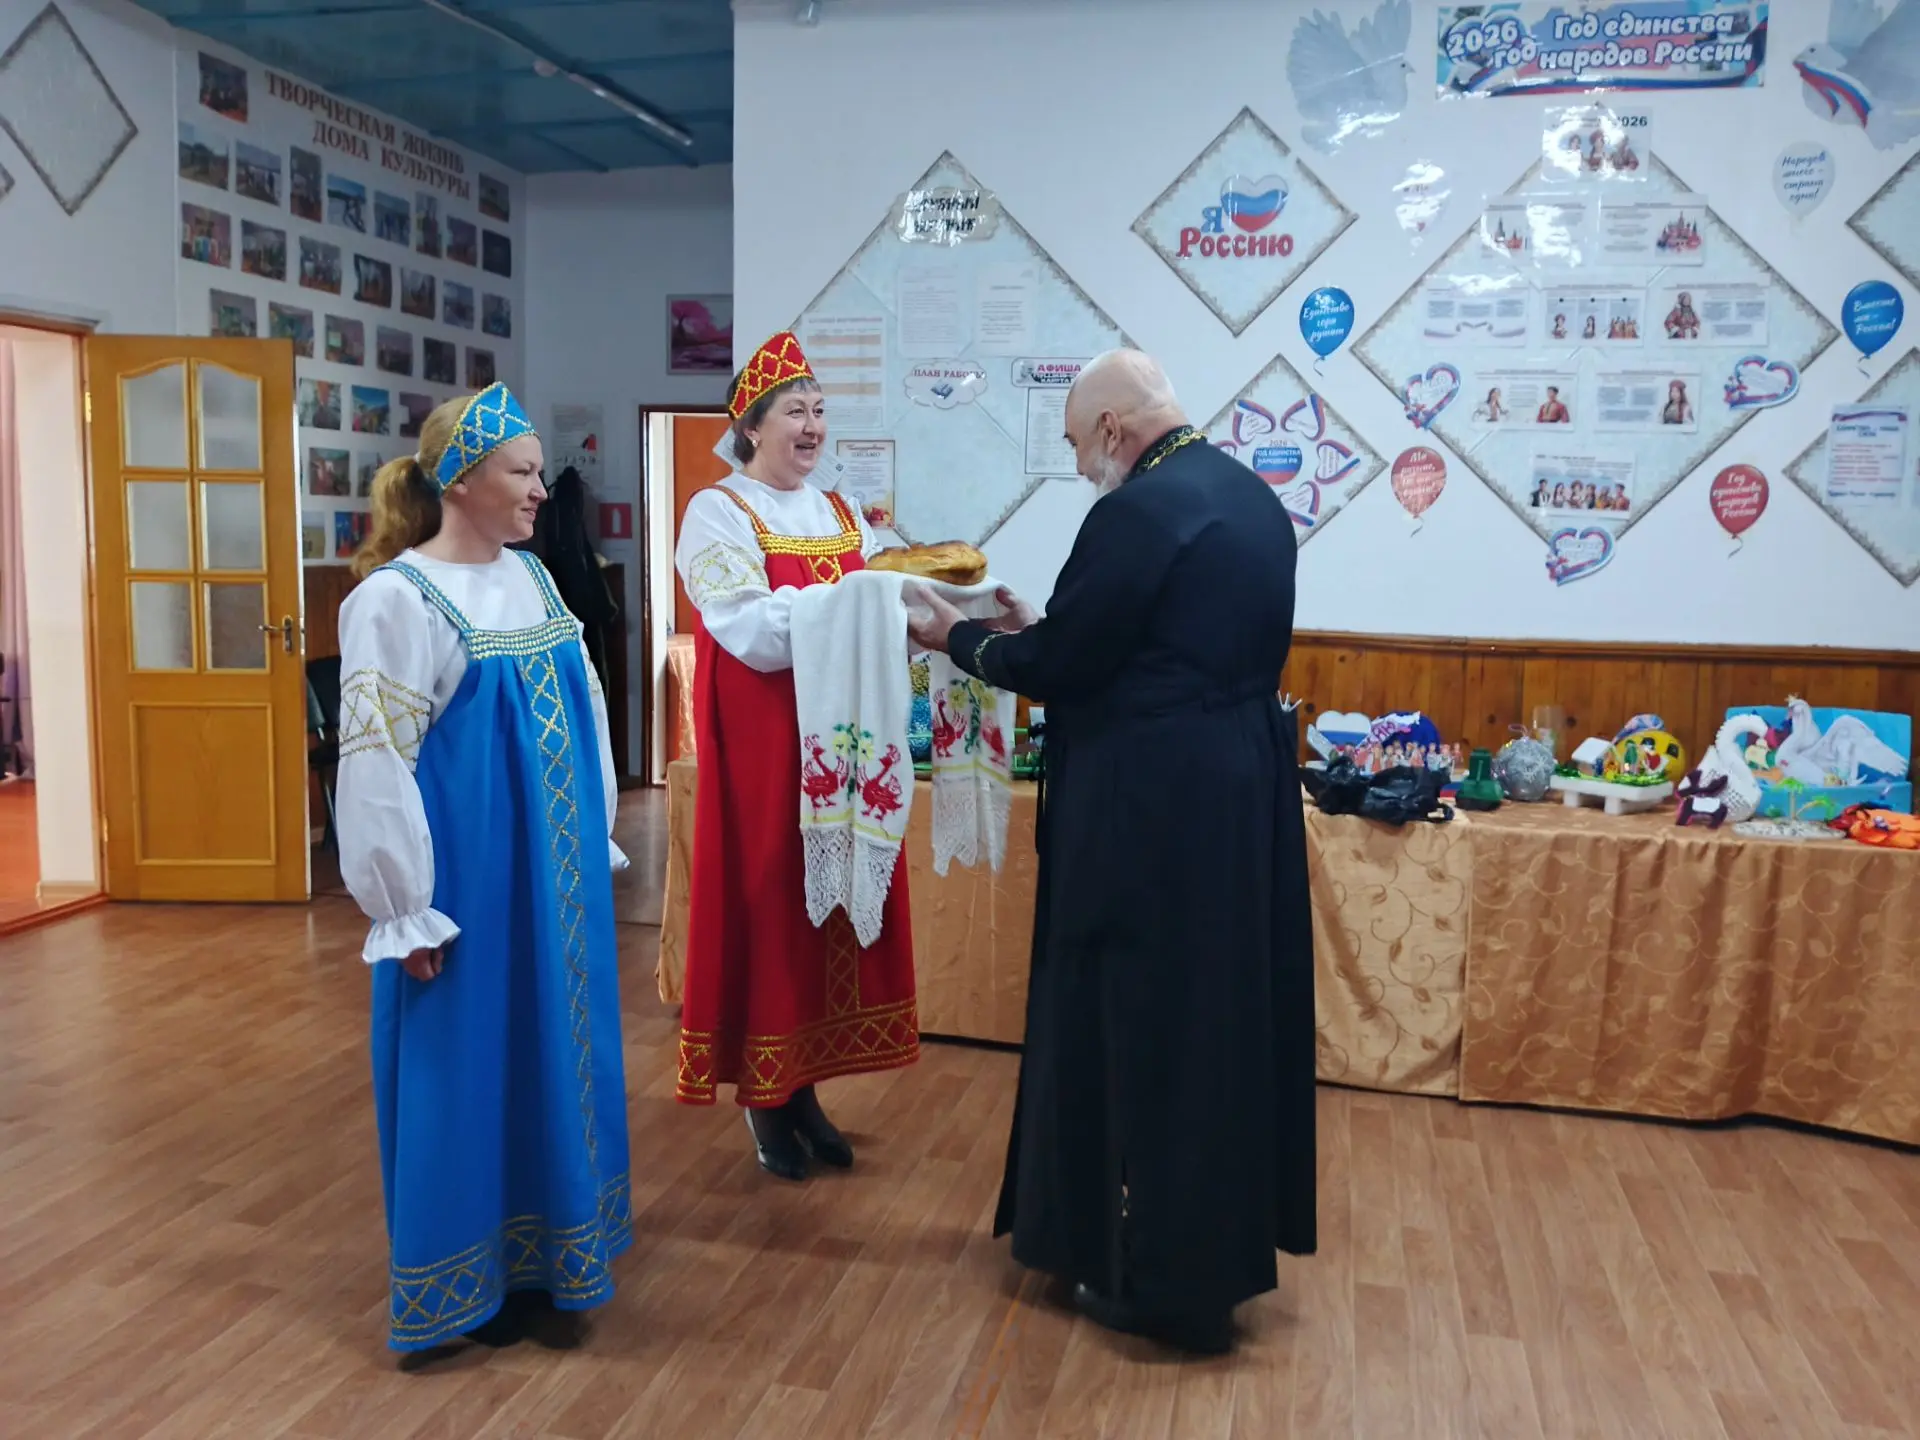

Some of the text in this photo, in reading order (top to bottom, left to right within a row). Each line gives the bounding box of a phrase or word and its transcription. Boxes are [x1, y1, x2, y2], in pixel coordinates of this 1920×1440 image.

[1553, 12, 1736, 41] Год единства
[1447, 20, 1537, 69] 2026 год
[1539, 40, 1754, 74] народов России
[265, 71, 464, 173] ТВОРЧЕСКАЯ ЖИЗНЬ
[1617, 116, 1648, 127] 026
[312, 120, 470, 200] ДОМА КУЛЬТУРЫ
[1200, 206, 1224, 233] Я
[914, 369, 940, 378] ПЛАН
[1037, 364, 1081, 372] АФИША
